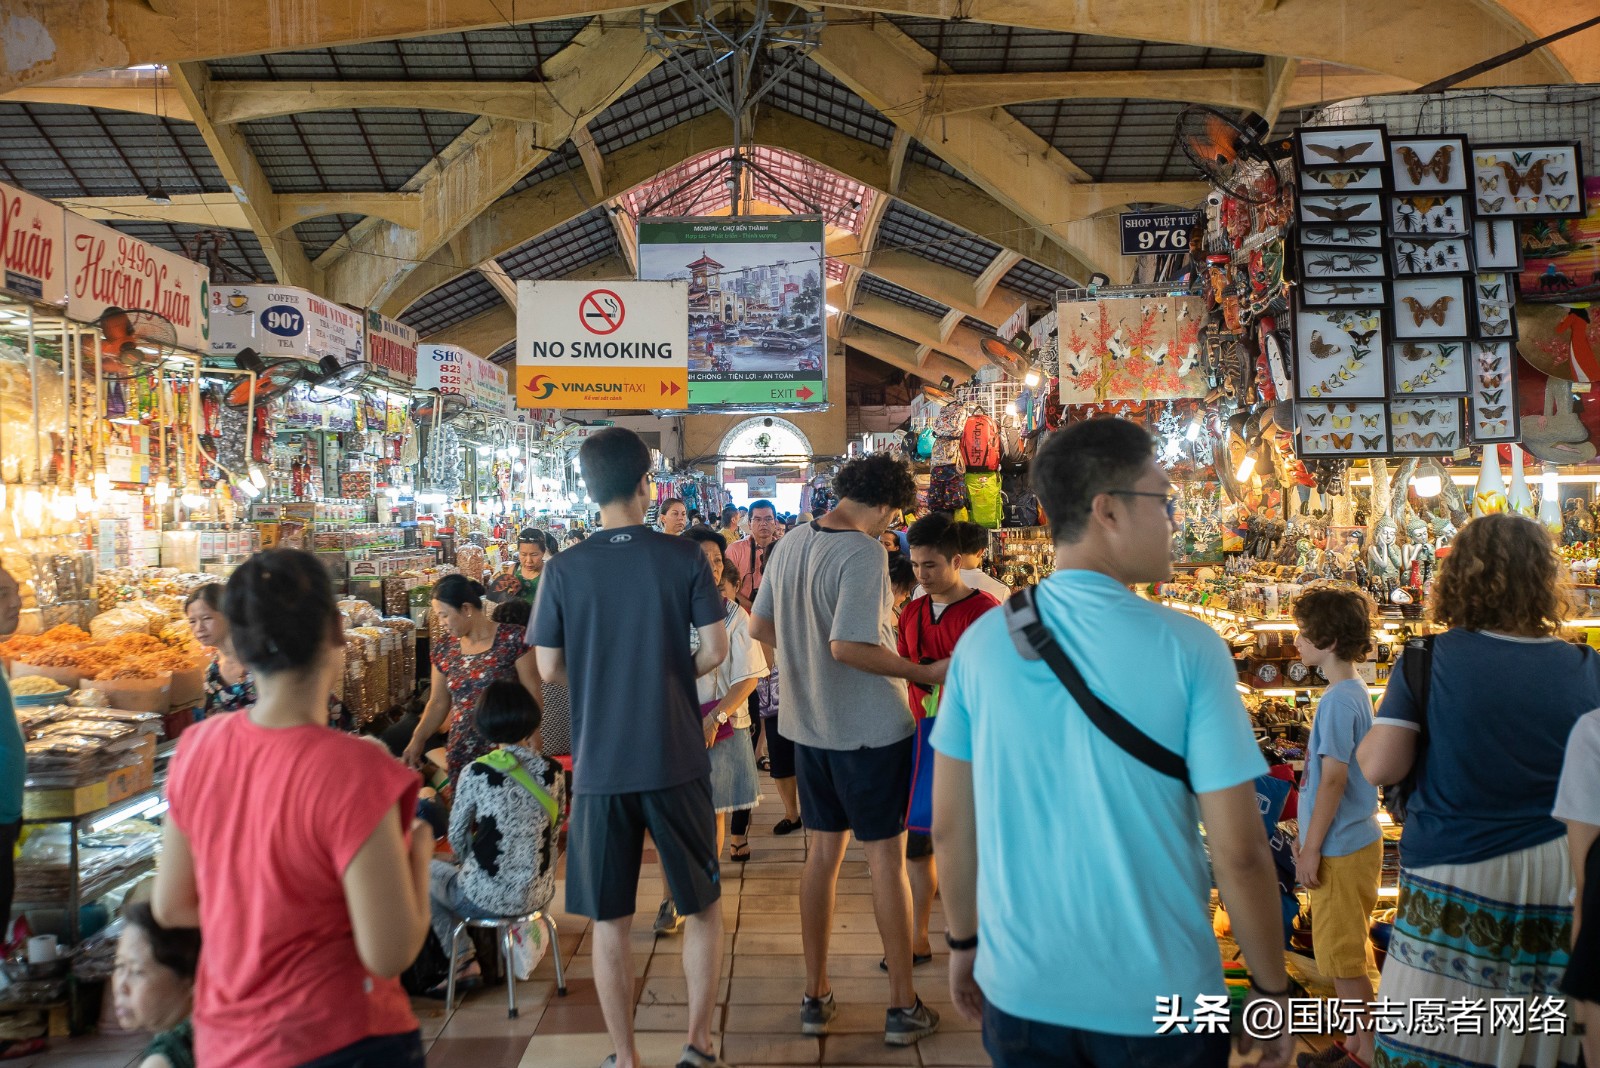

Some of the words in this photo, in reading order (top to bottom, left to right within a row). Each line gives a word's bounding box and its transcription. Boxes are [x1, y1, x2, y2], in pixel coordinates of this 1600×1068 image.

[722, 225, 735, 233] CHỢ
[736, 223, 748, 231] BẾN
[1125, 219, 1151, 228] SHOP
[1138, 229, 1187, 249] 976
[118, 237, 145, 272] 949
[213, 291, 221, 305] 3
[268, 294, 300, 303] COFFEE
[268, 311, 300, 330] 907
[278, 340, 294, 348] TEA
[533, 342, 565, 358] NO
[571, 342, 672, 359] SMOKING
[440, 364, 461, 374] 823
[440, 375, 461, 385] 825
[561, 383, 622, 392] VINASUN
[624, 384, 645, 392] TAXI
[771, 389, 794, 399] EXIT
